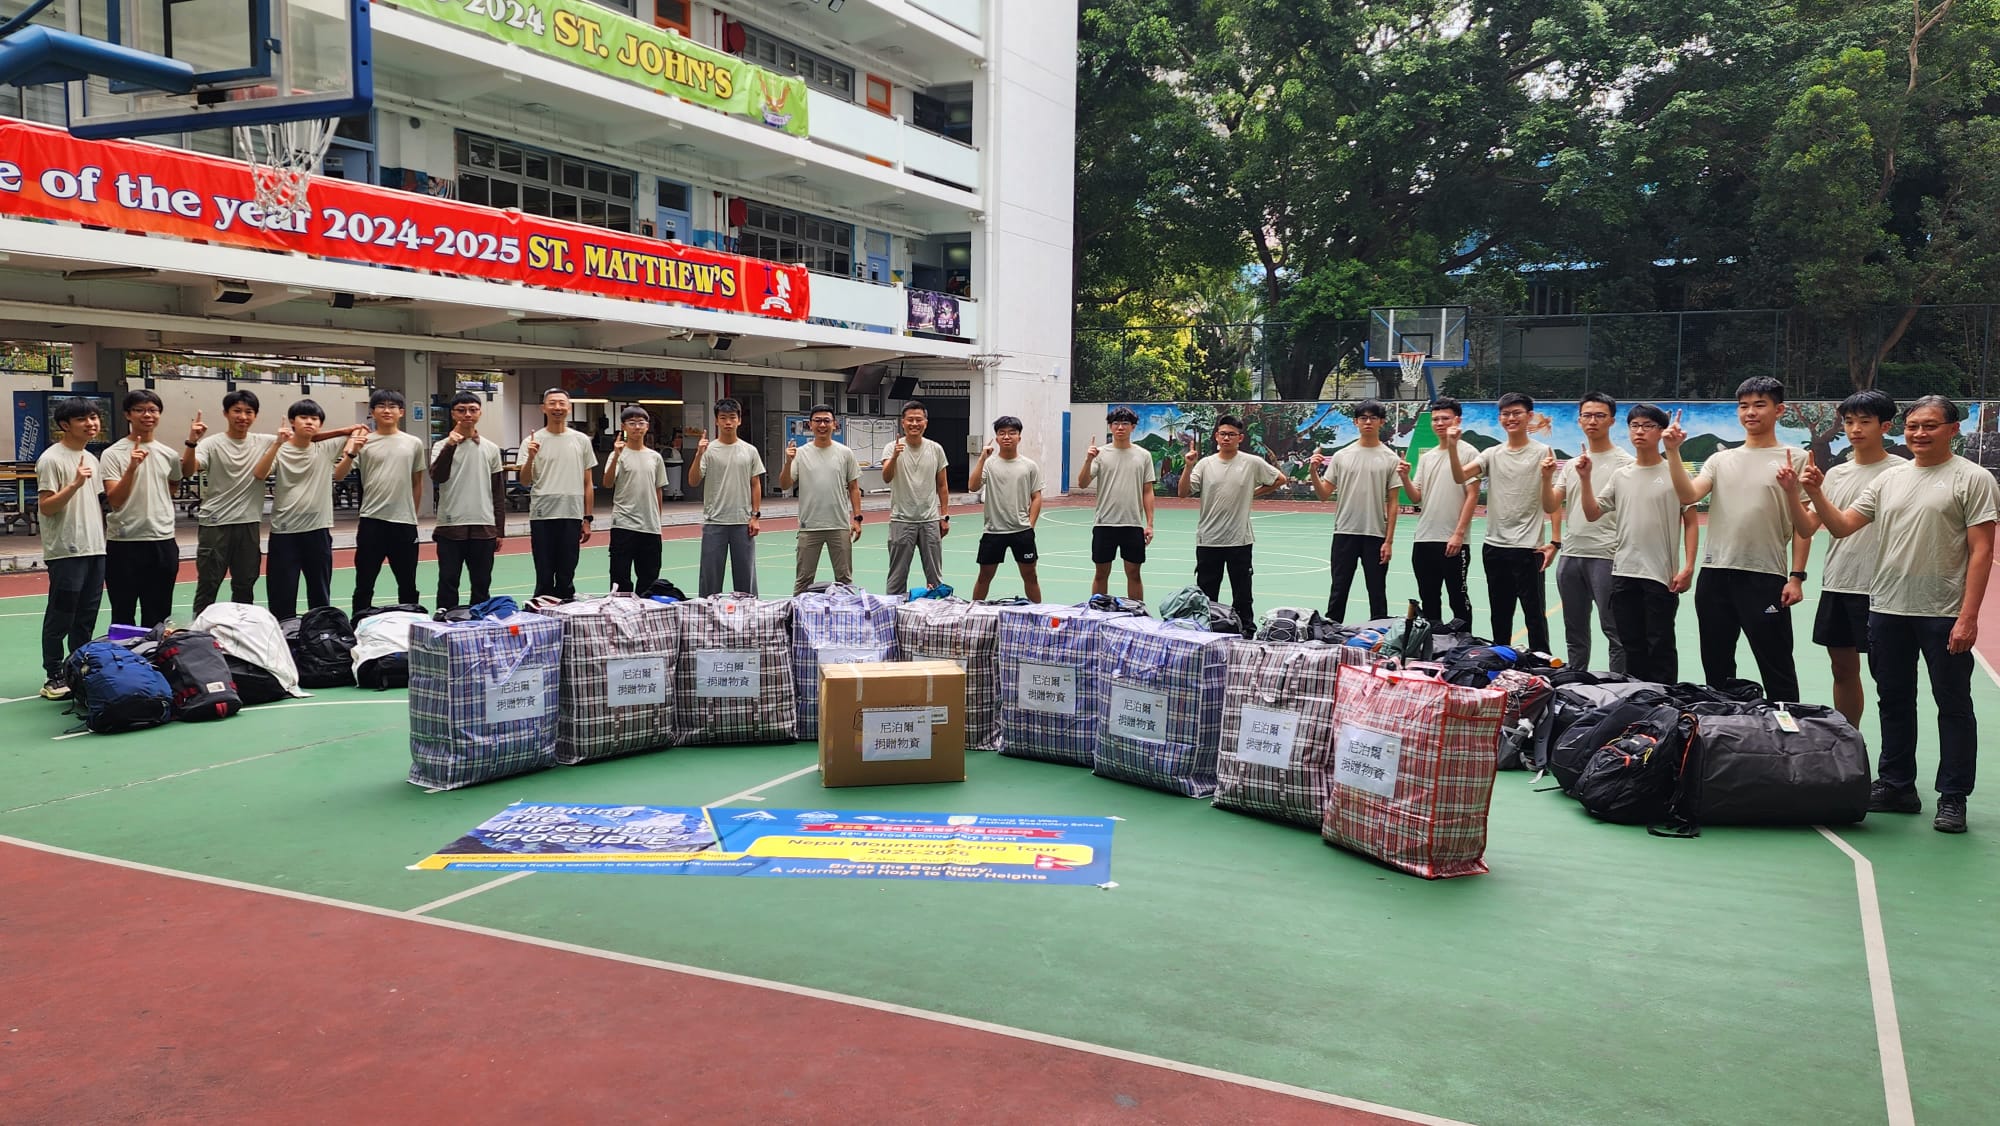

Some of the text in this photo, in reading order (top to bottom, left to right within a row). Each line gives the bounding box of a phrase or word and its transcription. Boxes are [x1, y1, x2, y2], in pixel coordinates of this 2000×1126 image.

[553, 9, 610, 59] ST.
[617, 33, 734, 100] JOHN'S
[40, 166, 102, 202] of
[115, 173, 202, 217] the
[213, 195, 312, 234] year
[322, 208, 521, 264] 2024-2025
[528, 233, 575, 273] ST.
[583, 243, 737, 298] MATTHEW'S
[622, 667, 651, 680] 尼泊爾
[712, 661, 744, 673] 尼泊爾
[706, 676, 750, 687] 捐贈物資
[1032, 674, 1060, 688] 尼泊爾
[617, 682, 657, 696] 捐贈物資
[1027, 689, 1066, 703] 捐贈物資
[496, 695, 536, 712] 捐贈物資
[1123, 698, 1151, 714] 尼泊爾
[879, 721, 914, 734] 尼泊爾
[1118, 713, 1157, 732] 捐贈物資
[1252, 721, 1281, 737] 尼泊爾
[874, 737, 921, 750] 捐贈物資
[1245, 737, 1282, 755] 捐贈物資
[1349, 739, 1383, 760] 尼泊爾
[1340, 757, 1387, 782] 捐贈物資
[510, 814, 561, 823] the
[524, 806, 635, 818] Making
[495, 823, 673, 835] Impossible
[850, 841, 1007, 852] Mountaineering
[786, 867, 853, 875] Journey
[985, 872, 1047, 880] Heights
